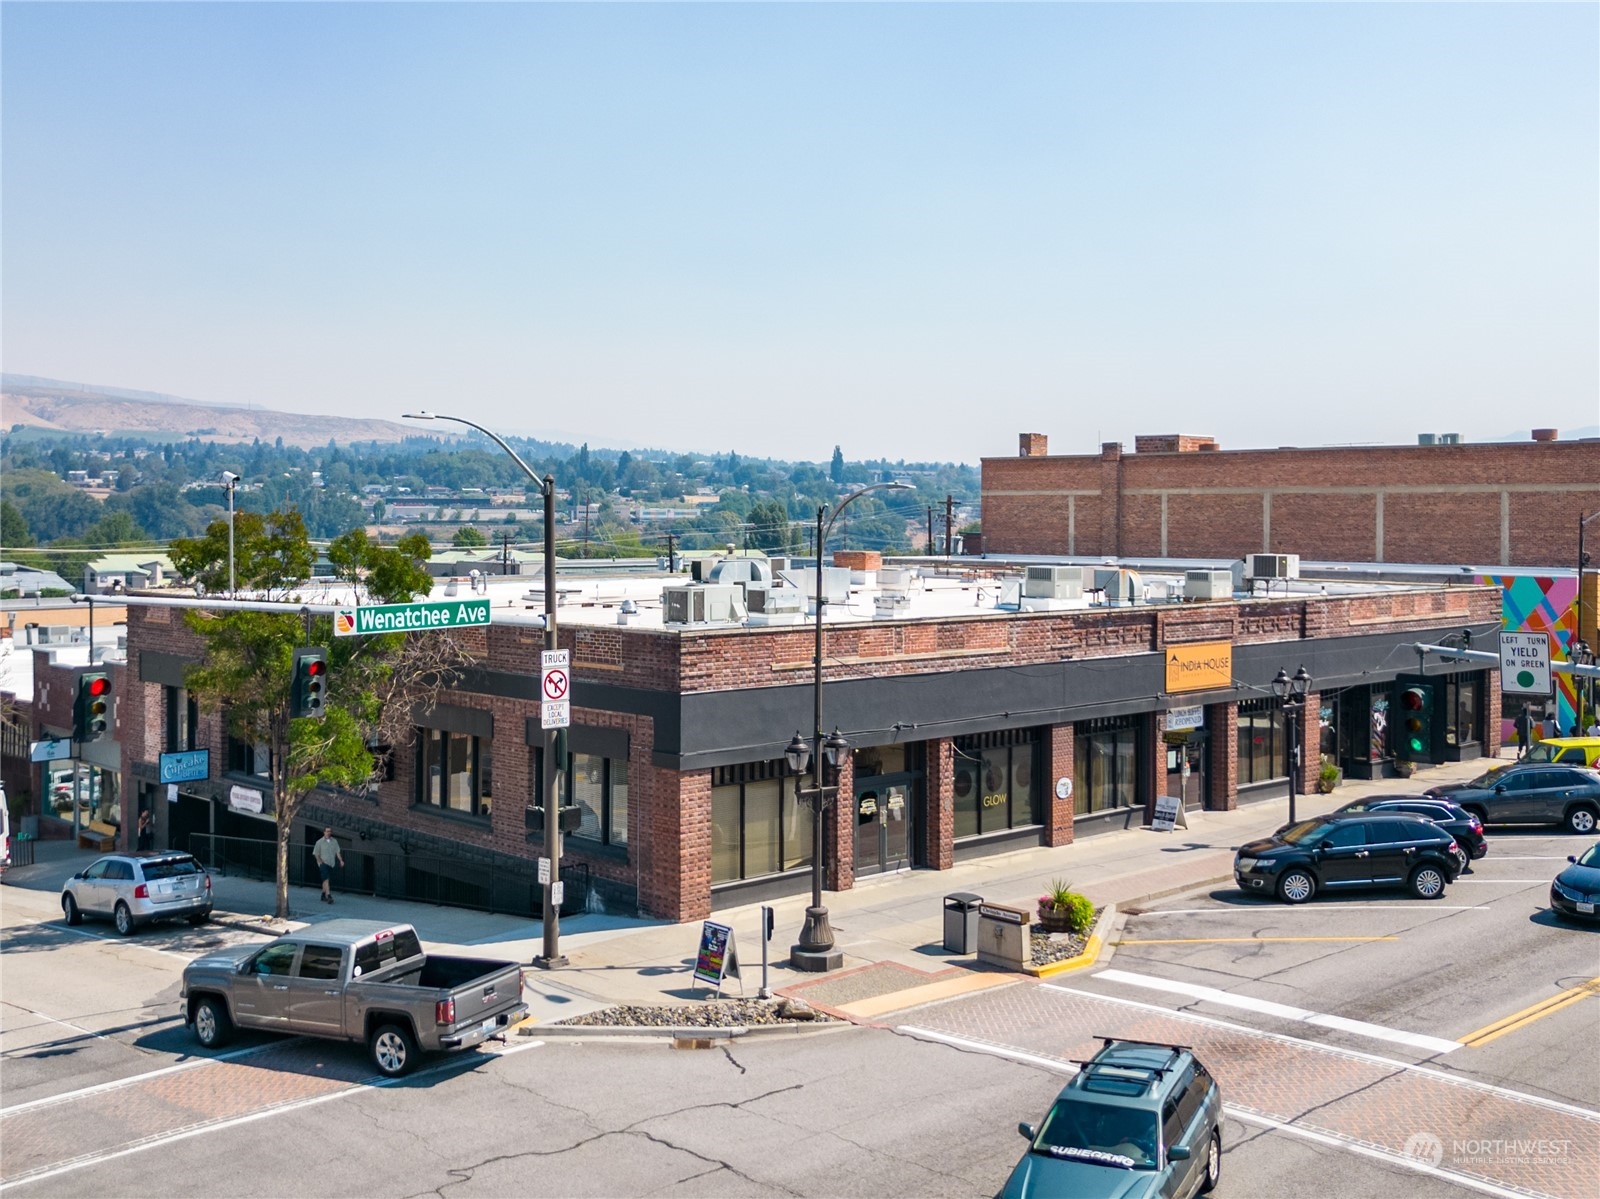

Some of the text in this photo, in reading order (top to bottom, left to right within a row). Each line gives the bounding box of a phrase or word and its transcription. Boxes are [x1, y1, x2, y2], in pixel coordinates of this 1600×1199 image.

[360, 604, 487, 630] Wenatchee Ave
[1501, 636, 1546, 645] LEFT TURN
[1511, 647, 1538, 657] YIELD
[544, 653, 567, 664] TRUCK
[1505, 659, 1545, 668] ON GREEN
[1181, 657, 1229, 672] INDIA HOUSE
[543, 718, 568, 726] DELIVERIES
[1174, 716, 1202, 726] REOPENED
[164, 754, 206, 779] Cupcake
[983, 793, 1008, 807] GLOW
[1050, 1145, 1135, 1167] SUBIEGANG
